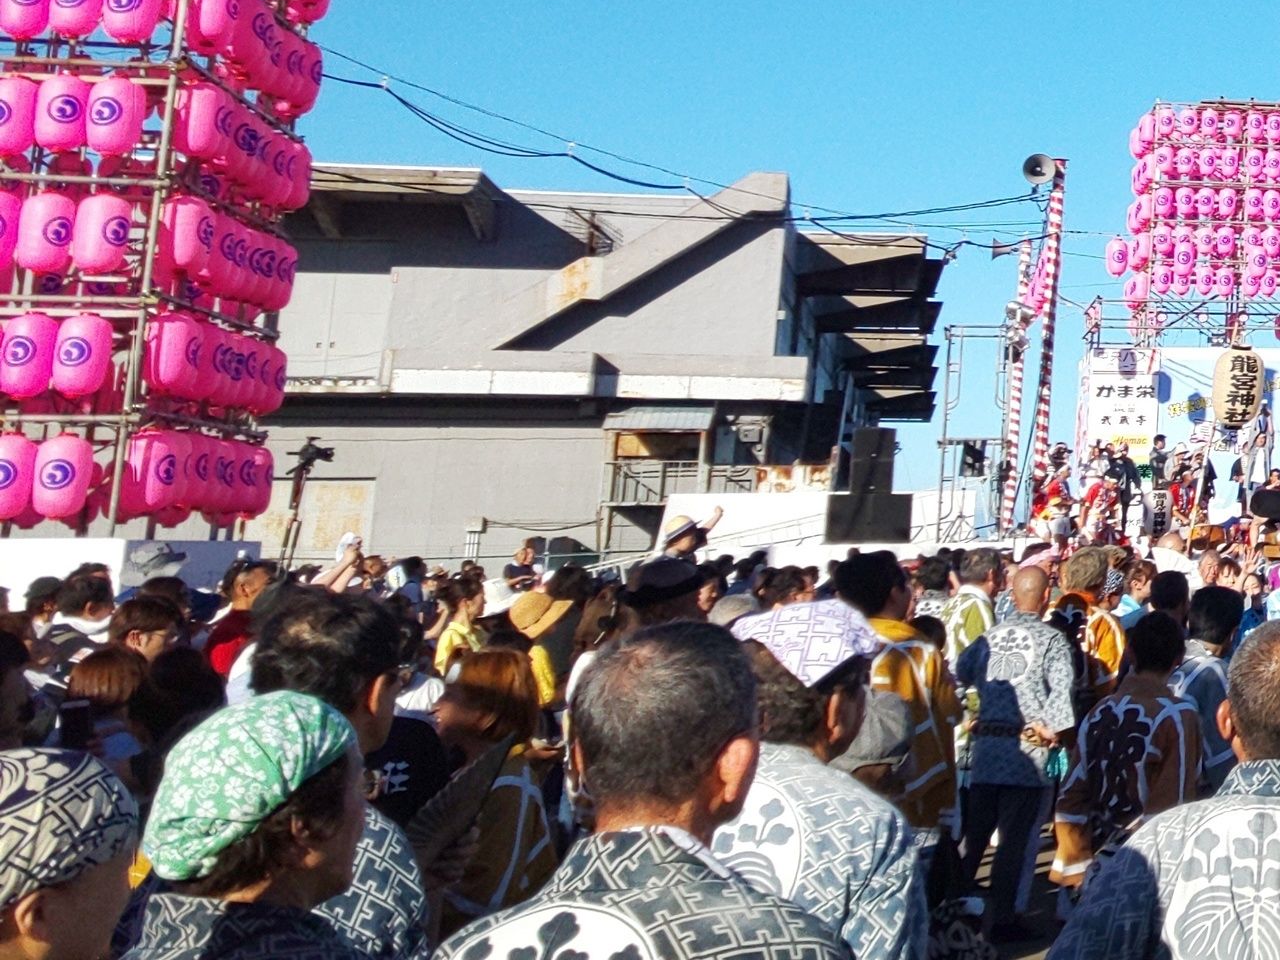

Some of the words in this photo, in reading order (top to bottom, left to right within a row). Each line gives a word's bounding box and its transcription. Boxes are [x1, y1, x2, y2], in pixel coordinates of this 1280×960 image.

[1096, 385, 1156, 398] かま栄
[1224, 355, 1258, 423] 龍宮神社
